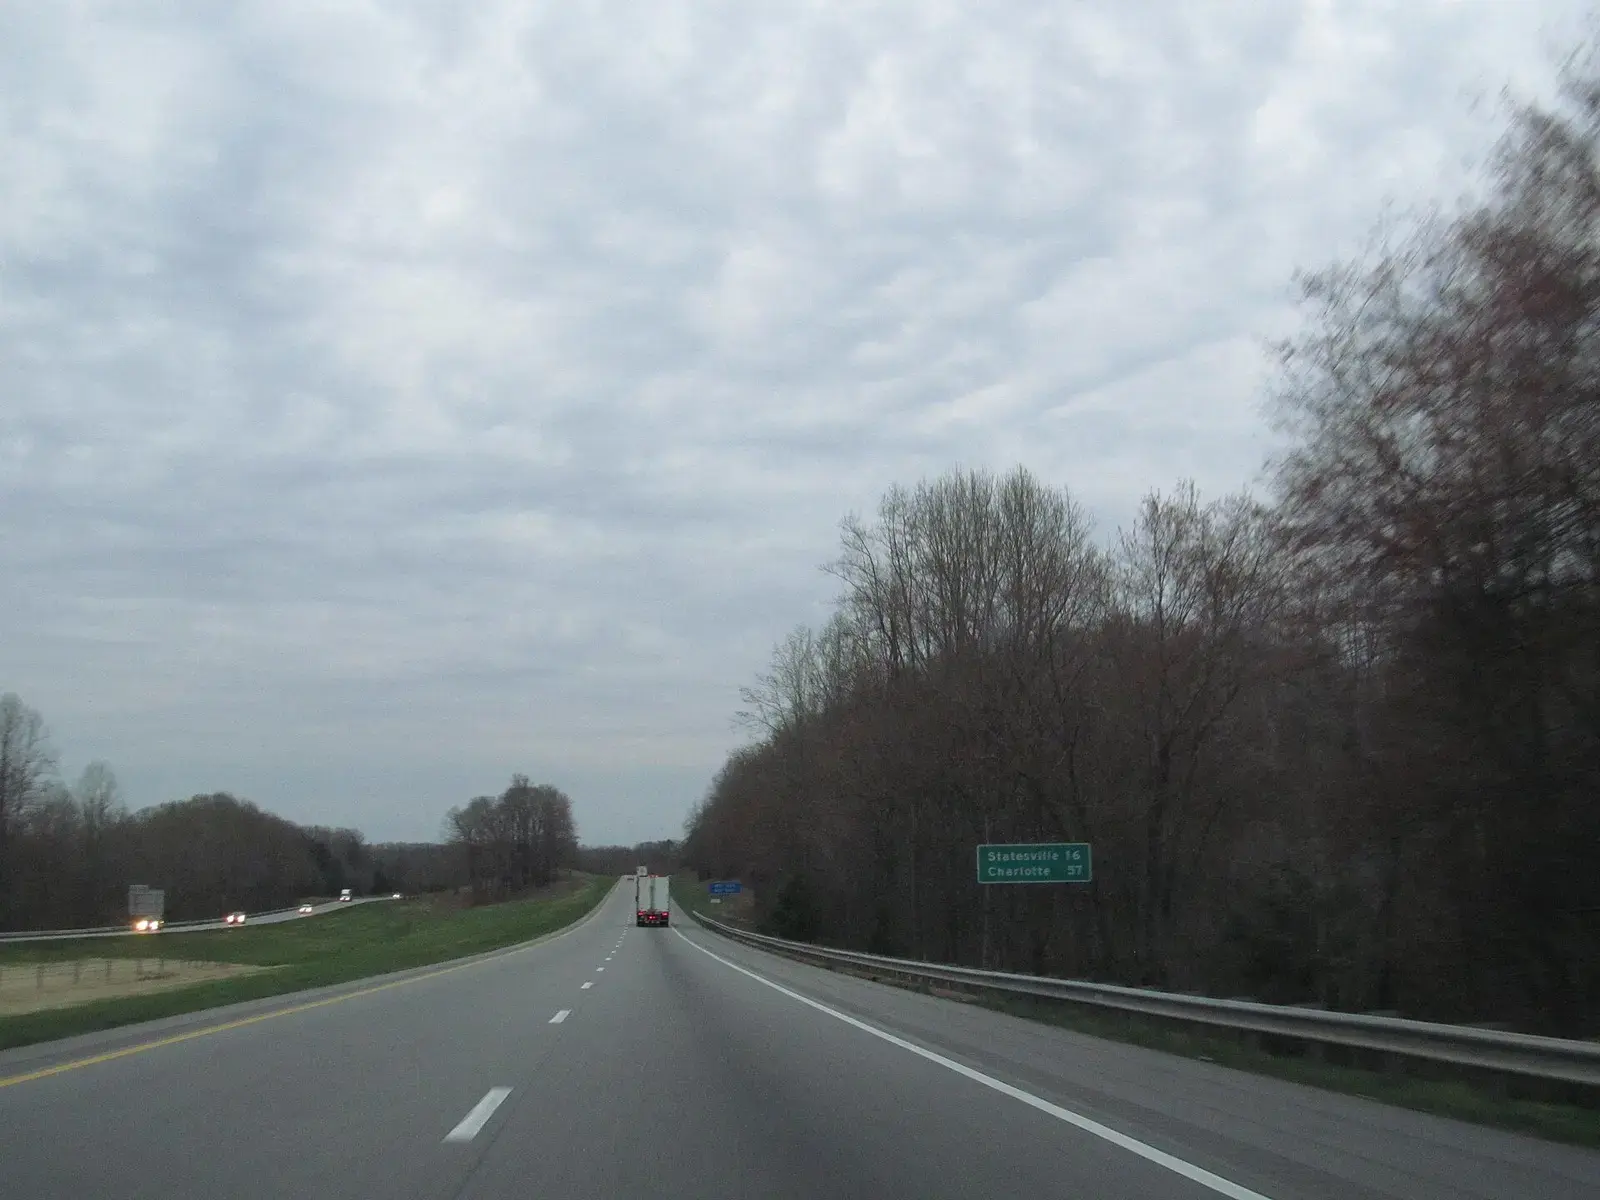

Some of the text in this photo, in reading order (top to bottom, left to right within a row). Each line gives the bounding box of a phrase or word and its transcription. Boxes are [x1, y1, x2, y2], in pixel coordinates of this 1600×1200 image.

[987, 850, 1081, 861] Statesville 16
[987, 865, 1083, 877] Charlotte 57
